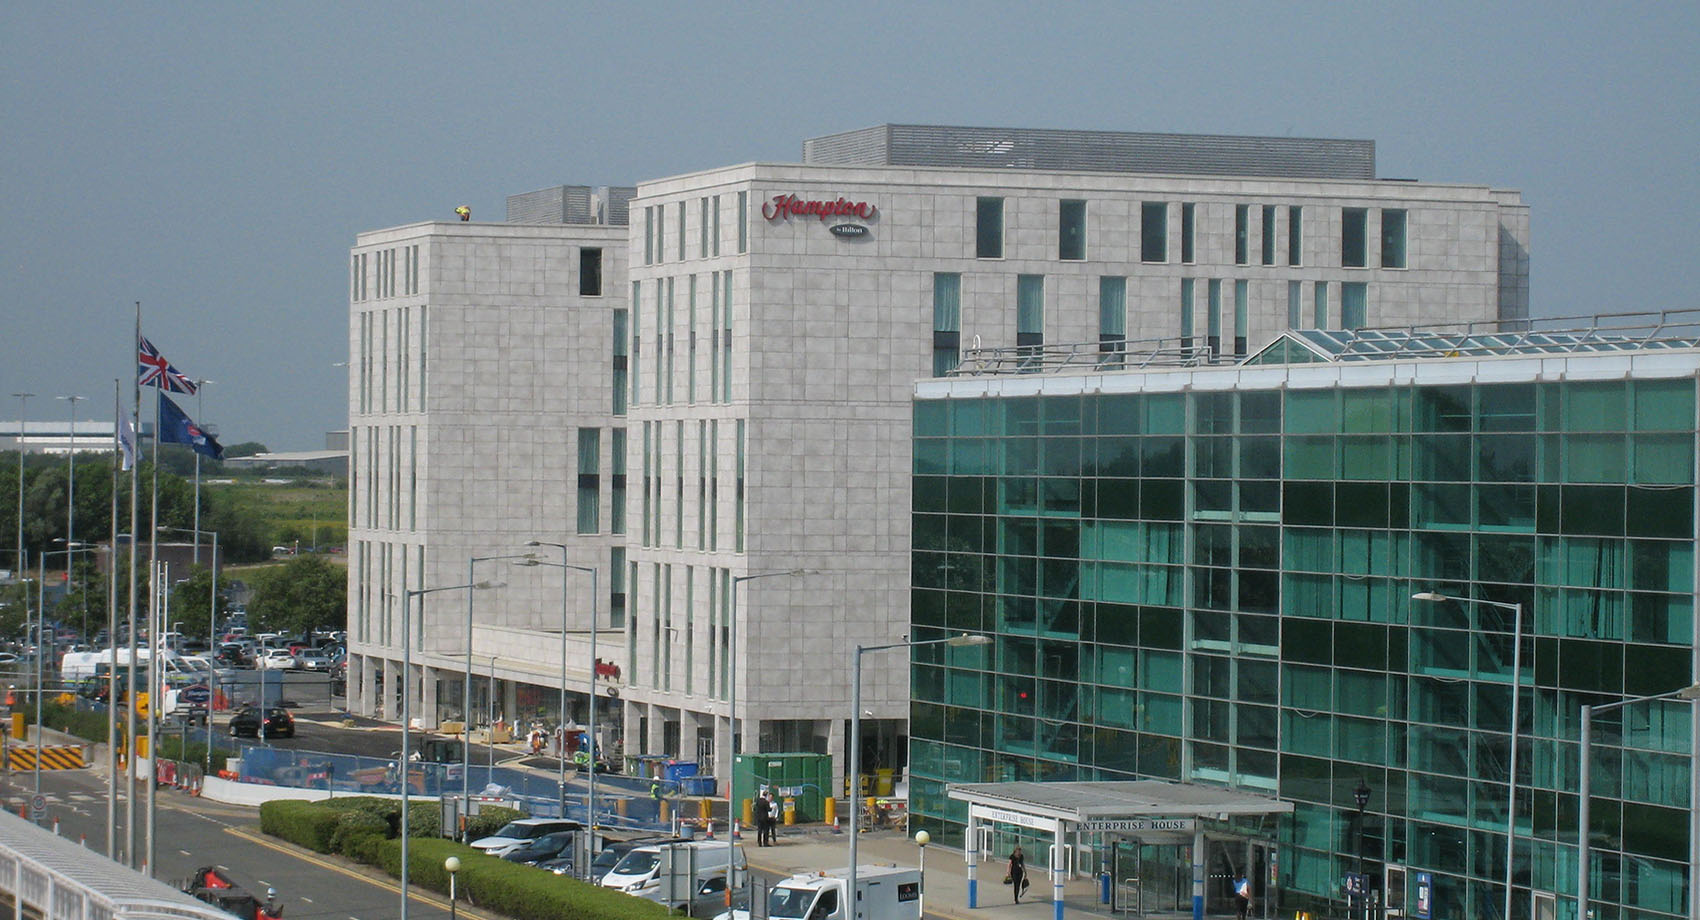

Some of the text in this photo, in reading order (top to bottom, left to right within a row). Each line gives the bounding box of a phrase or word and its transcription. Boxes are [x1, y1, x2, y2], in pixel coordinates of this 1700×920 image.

[762, 193, 876, 221] Hampton
[991, 811, 1034, 826] ENTERPRISE HOUSE
[1076, 820, 1186, 830] ENTERPRISE HOUSE
